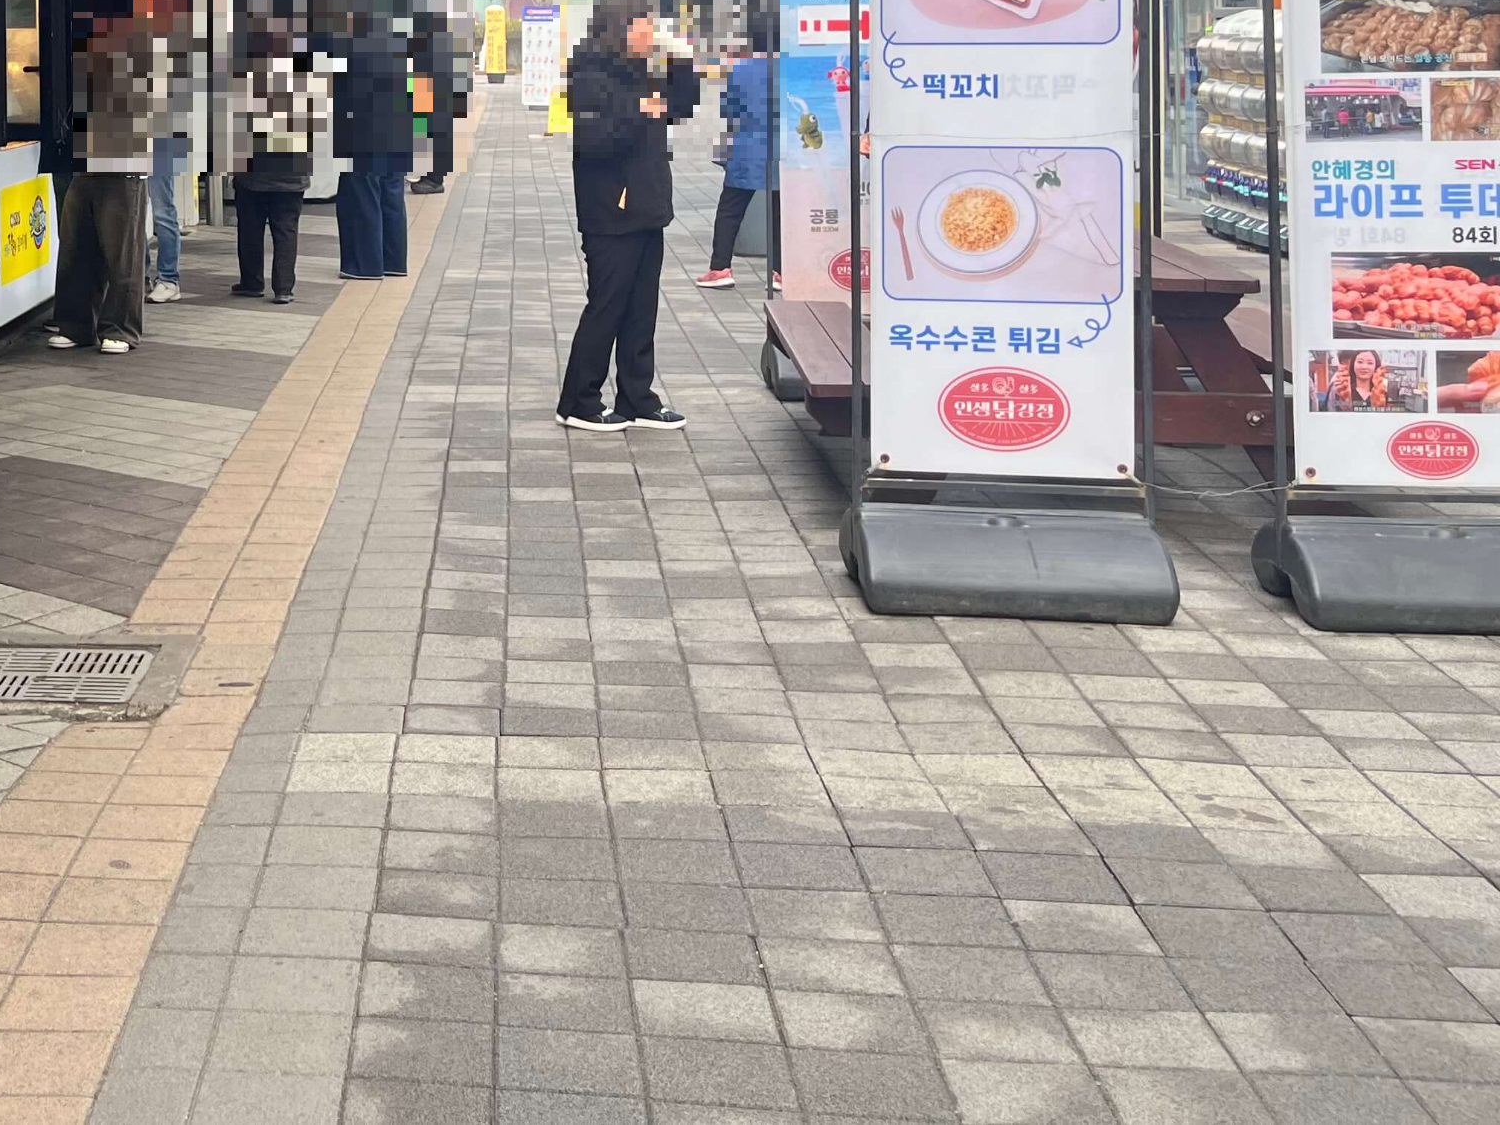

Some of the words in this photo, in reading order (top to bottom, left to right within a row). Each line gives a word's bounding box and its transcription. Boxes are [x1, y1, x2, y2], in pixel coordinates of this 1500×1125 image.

[923, 73, 999, 99] 떡꼬치
[1312, 159, 1395, 181] 안혜경의
[1455, 159, 1495, 170] SEN
[1314, 183, 1423, 219] 라이프
[1452, 226, 1497, 244] 84회
[888, 324, 997, 353] 옥수수콘
[1007, 326, 1061, 355] 튀김
[953, 400, 1054, 420] 인생닭강정
[1398, 444, 1468, 458] 인생닭강정
